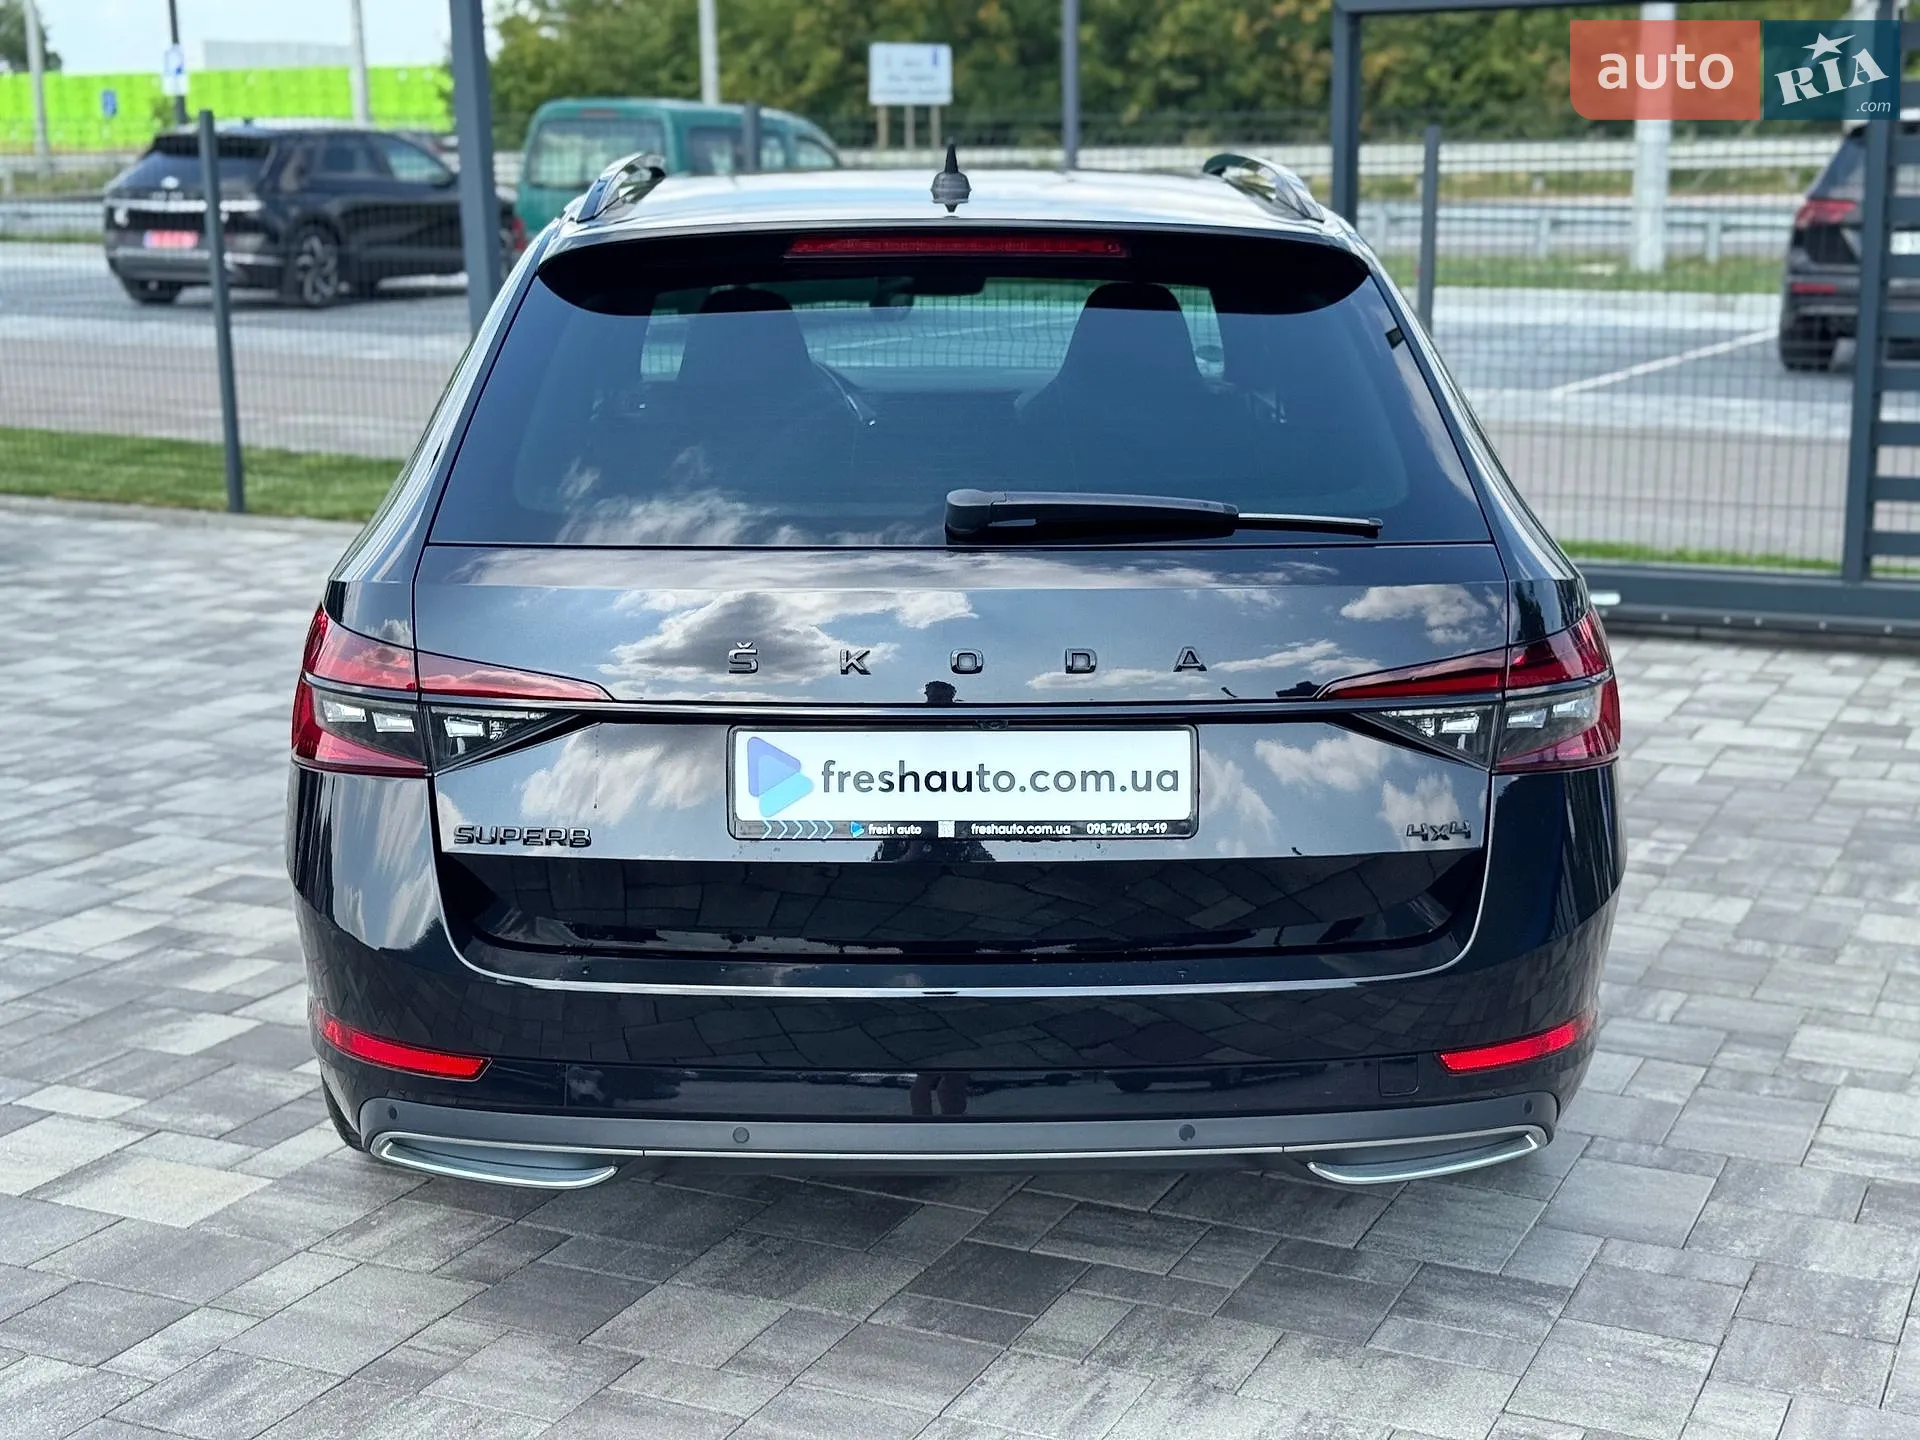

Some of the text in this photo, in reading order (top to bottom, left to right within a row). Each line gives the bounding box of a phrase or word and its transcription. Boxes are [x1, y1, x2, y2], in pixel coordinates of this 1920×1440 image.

[728, 641, 1208, 675] ŠKODA
[821, 759, 1180, 792] freshauto.com.ua
[453, 825, 592, 848] SUPERB
[868, 823, 922, 835] fresh auto
[971, 823, 1071, 835] freshauto.com.ua
[1086, 823, 1168, 834] 098-708-19-19
